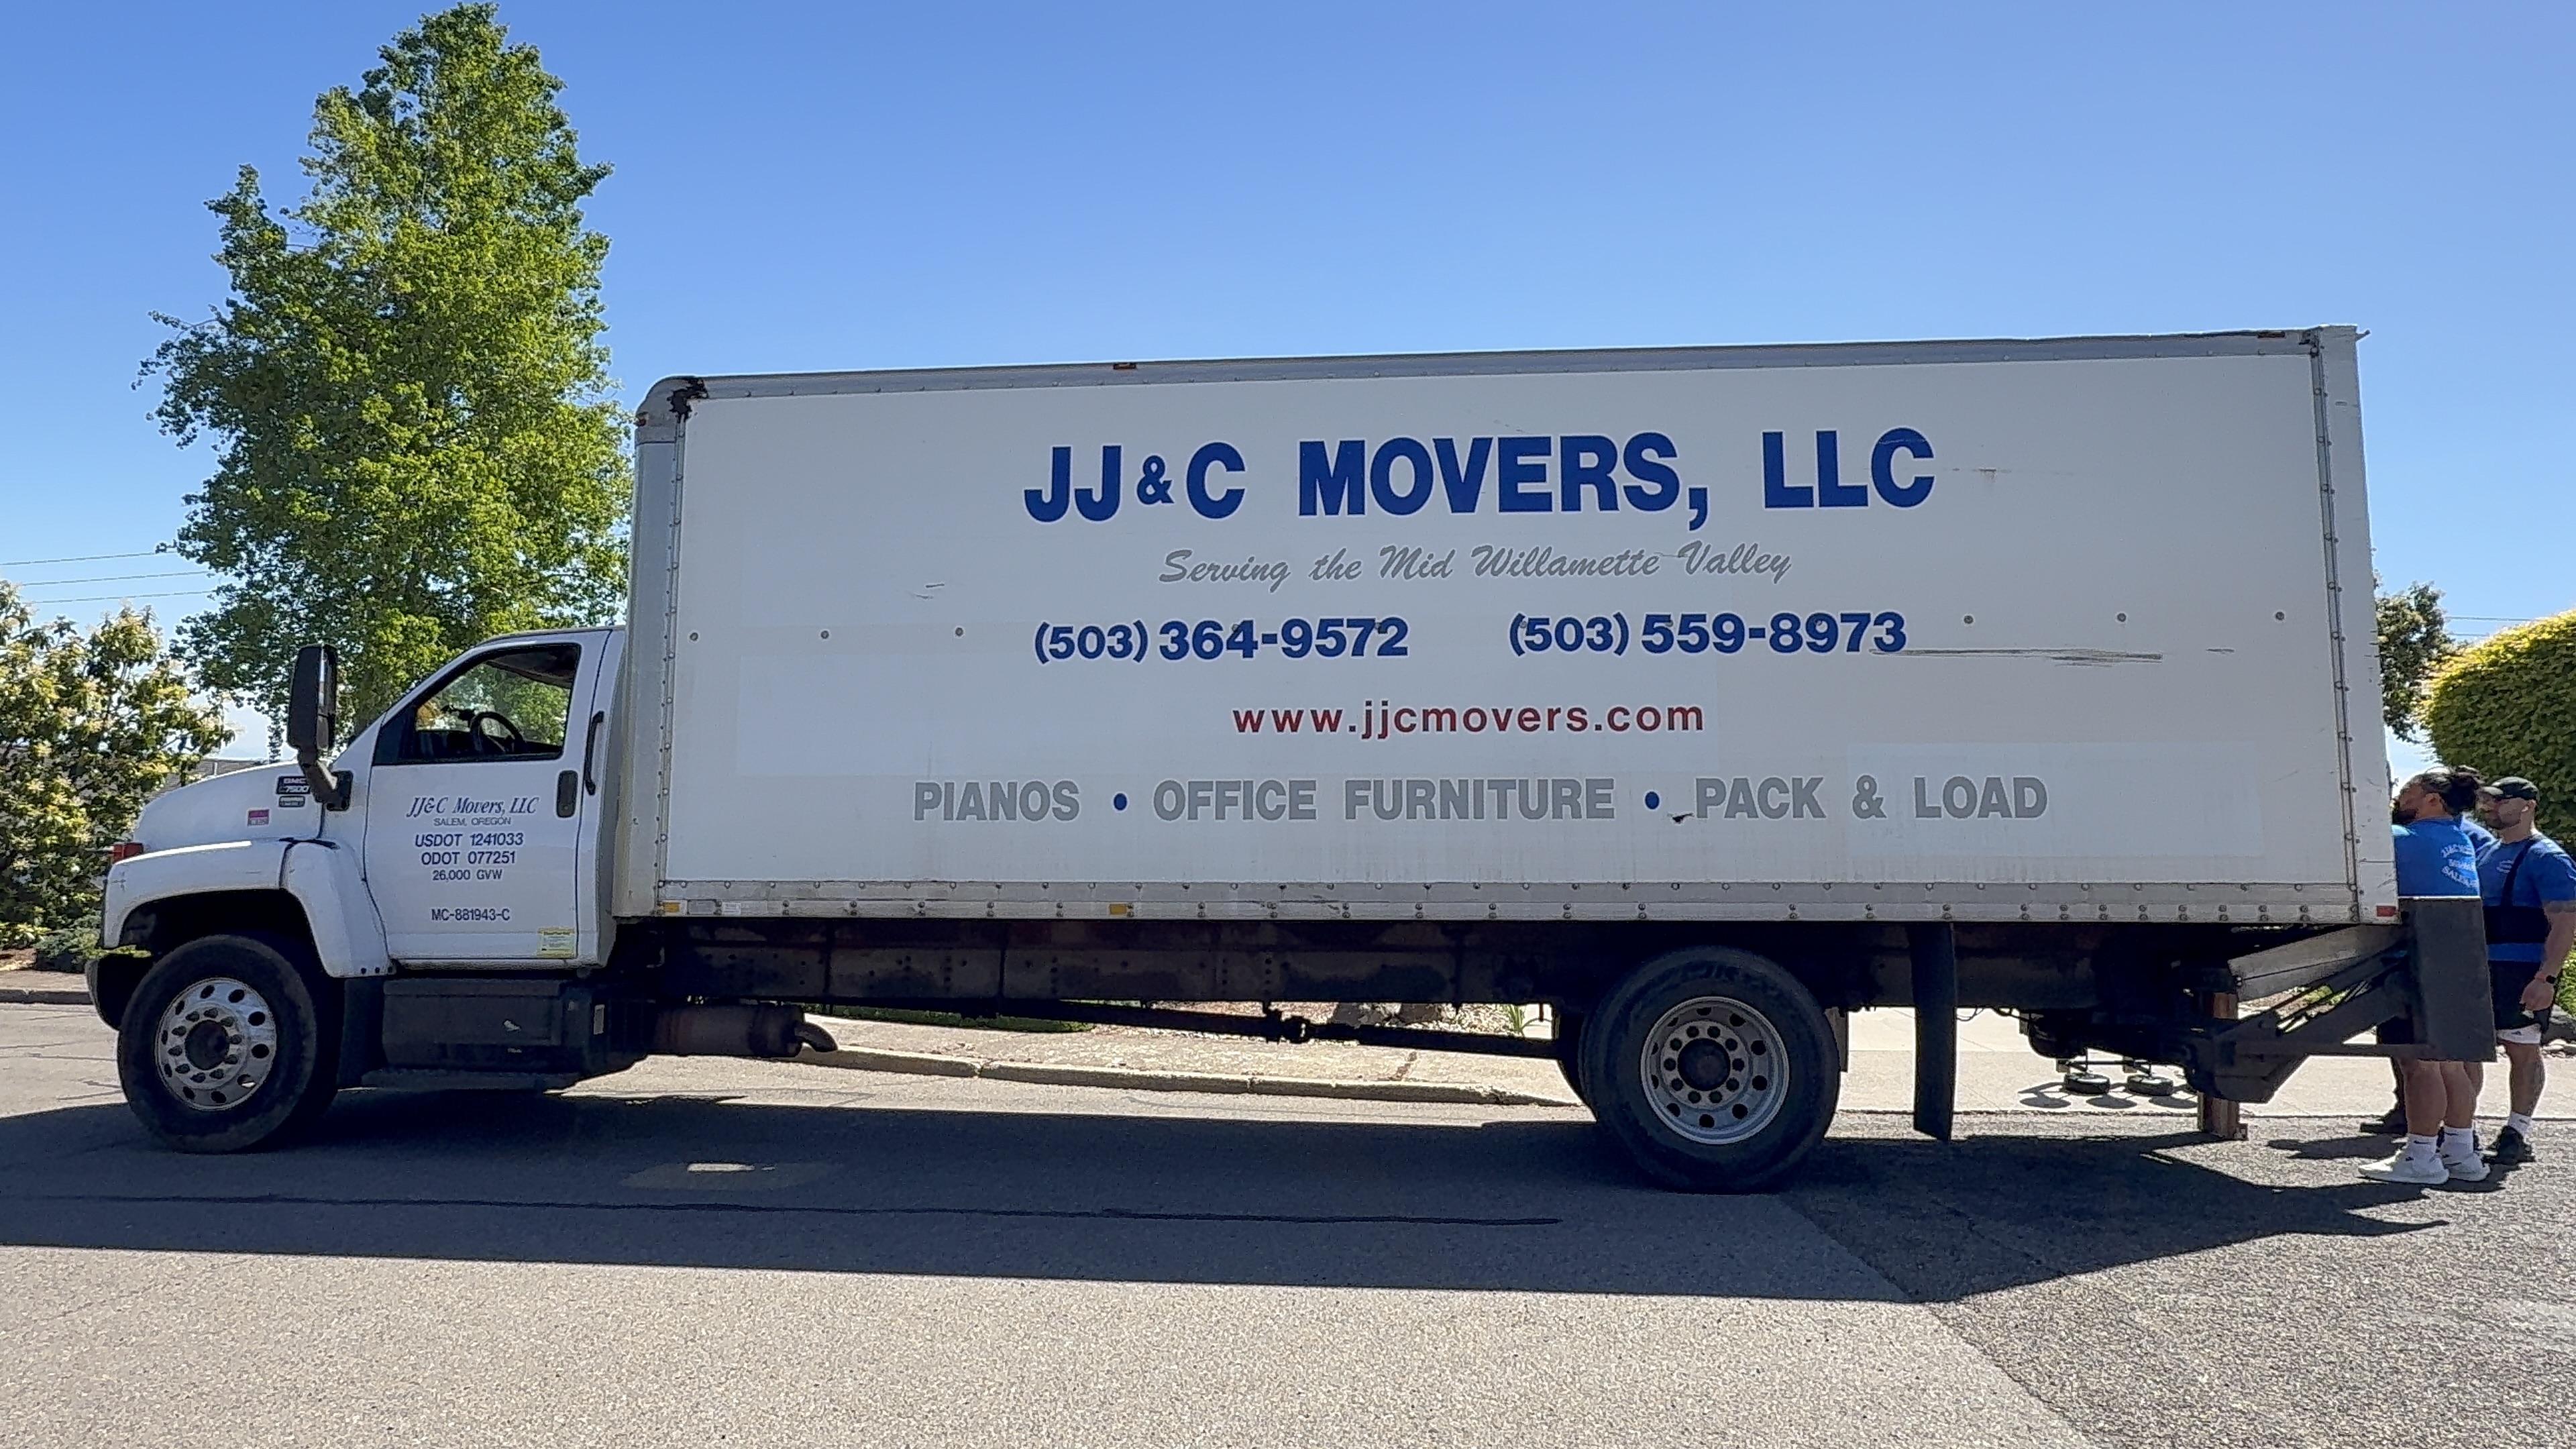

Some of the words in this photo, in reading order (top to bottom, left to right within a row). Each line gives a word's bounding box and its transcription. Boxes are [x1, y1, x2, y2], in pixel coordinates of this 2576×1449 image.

[1298, 432, 1708, 531] MOVERS,
[1762, 427, 1935, 508] LLC
[1159, 549, 1291, 593] Serving
[1309, 547, 1362, 581] the
[1379, 545, 1456, 580] Mid
[1470, 544, 1660, 578] Willamette
[1678, 540, 1792, 584] Valley
[1034, 621, 1148, 664] (503)
[1159, 616, 1409, 660] 364-9572
[1509, 612, 1629, 657] (503)
[1641, 611, 1907, 654] 559-8973
[1232, 700, 1705, 739] www.jjcmovers.com
[451, 796, 506, 816] Movers,
[510, 796, 540, 814] LLC
[913, 780, 1080, 822] PIANOS
[1152, 780, 1318, 822] OFFICE
[1345, 777, 1615, 820] FURNITURE
[1695, 776, 1825, 820] PACK
[1851, 773, 1887, 819] &
[1915, 775, 2049, 819] LOAD
[415, 833, 463, 848] USDOT
[470, 833, 524, 846] 1241033
[471, 816, 512, 826] OREGON
[421, 851, 460, 865] ODOT
[468, 851, 516, 864] 077251
[432, 869, 470, 882] 26,000
[476, 869, 502, 879] GVW
